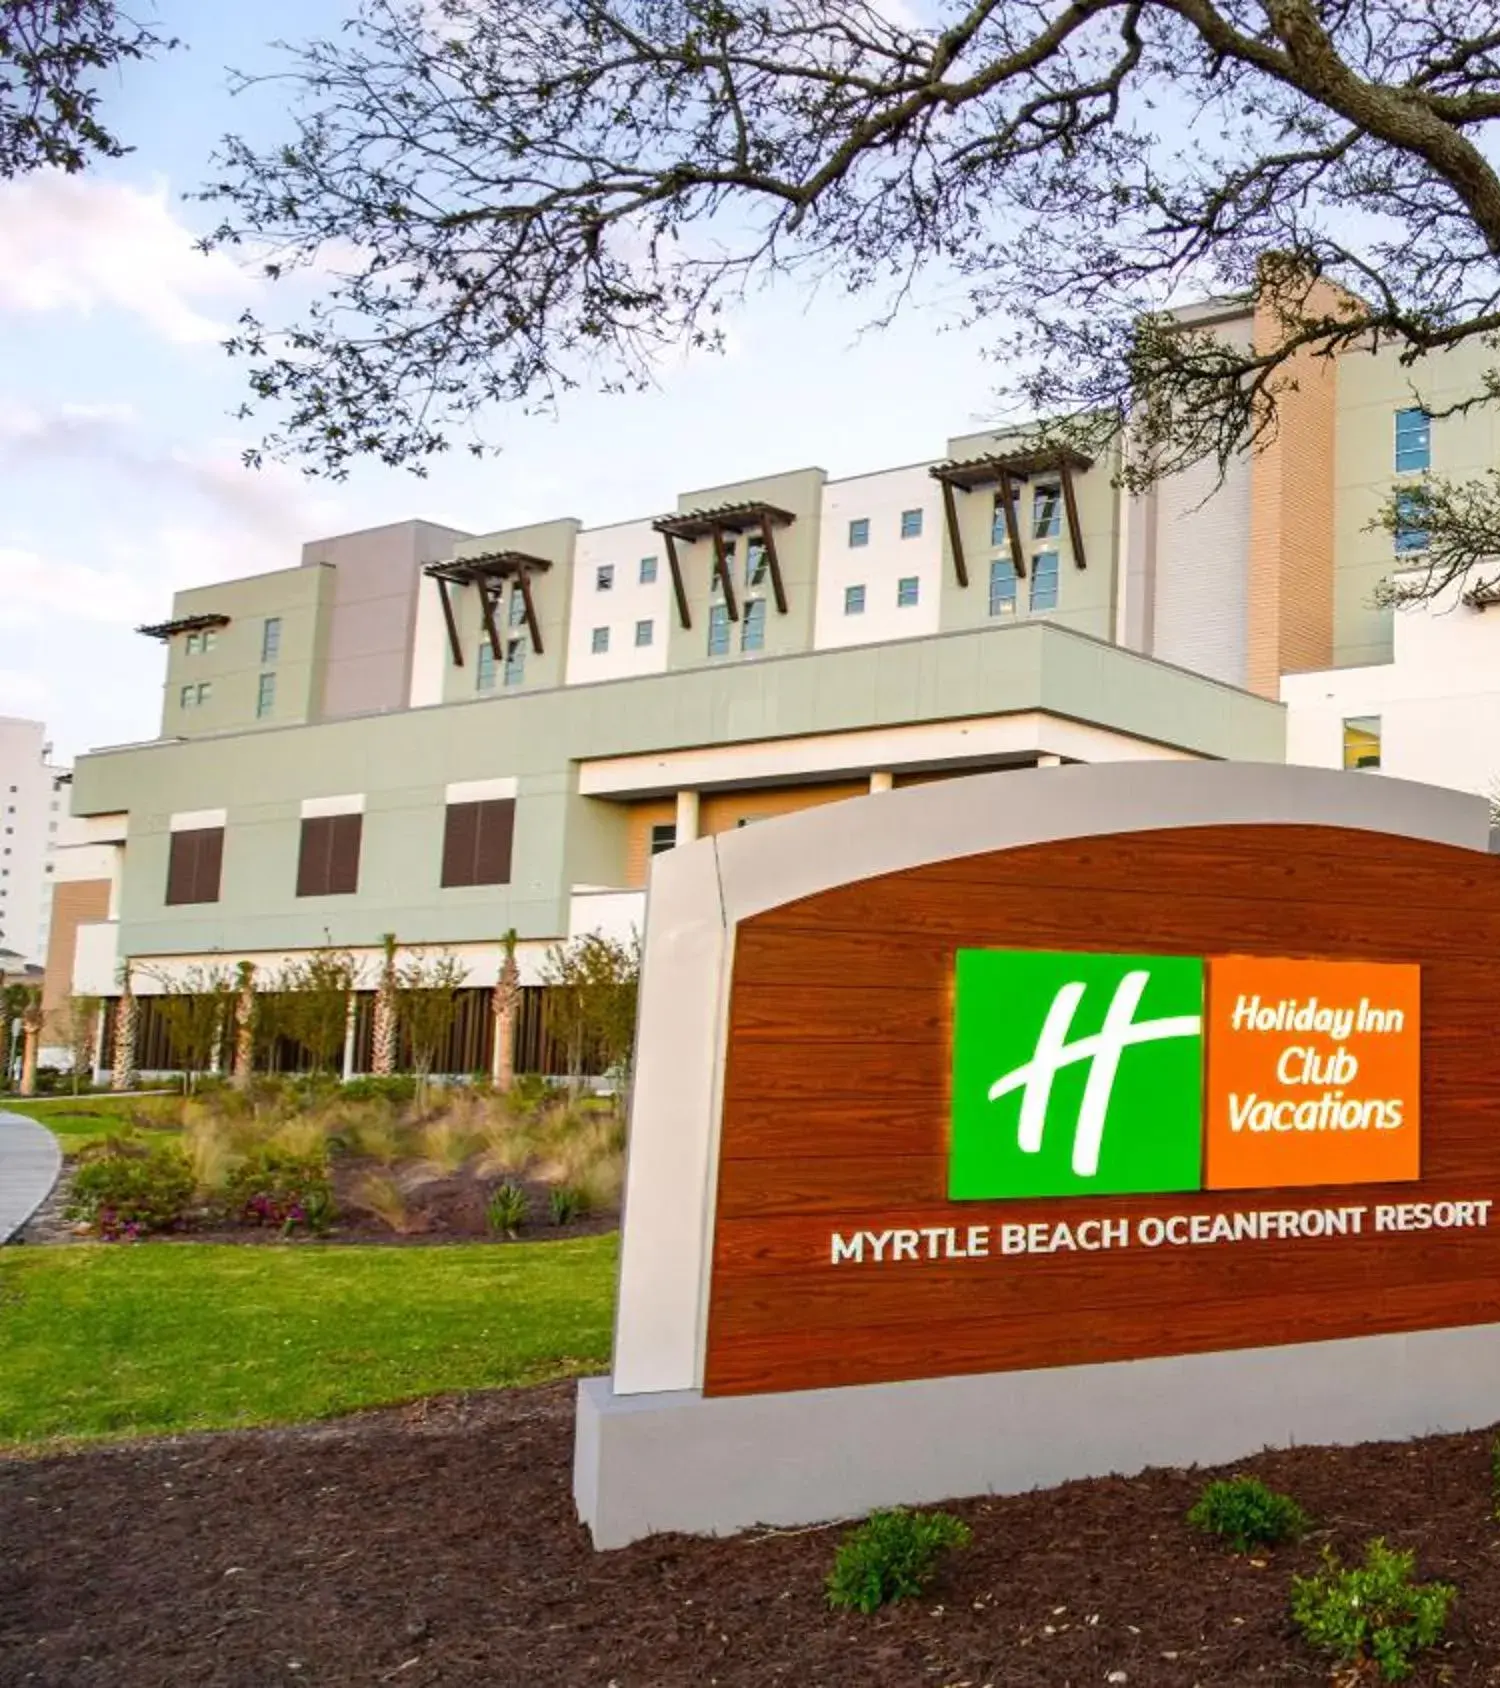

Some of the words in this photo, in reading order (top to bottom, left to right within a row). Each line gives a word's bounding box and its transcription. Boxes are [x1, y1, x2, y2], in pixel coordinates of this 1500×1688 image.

[1232, 995, 1353, 1040] Holiday
[1356, 997, 1404, 1033] Inn
[987, 970, 1201, 1177] H
[1276, 1046, 1358, 1085] Club
[1228, 1091, 1404, 1132] Vacations
[831, 1226, 989, 1264] MYRTLE
[1001, 1219, 1128, 1255] BEACH
[1138, 1207, 1367, 1246] OCEANFRONT
[1375, 1200, 1493, 1231] RESORT
